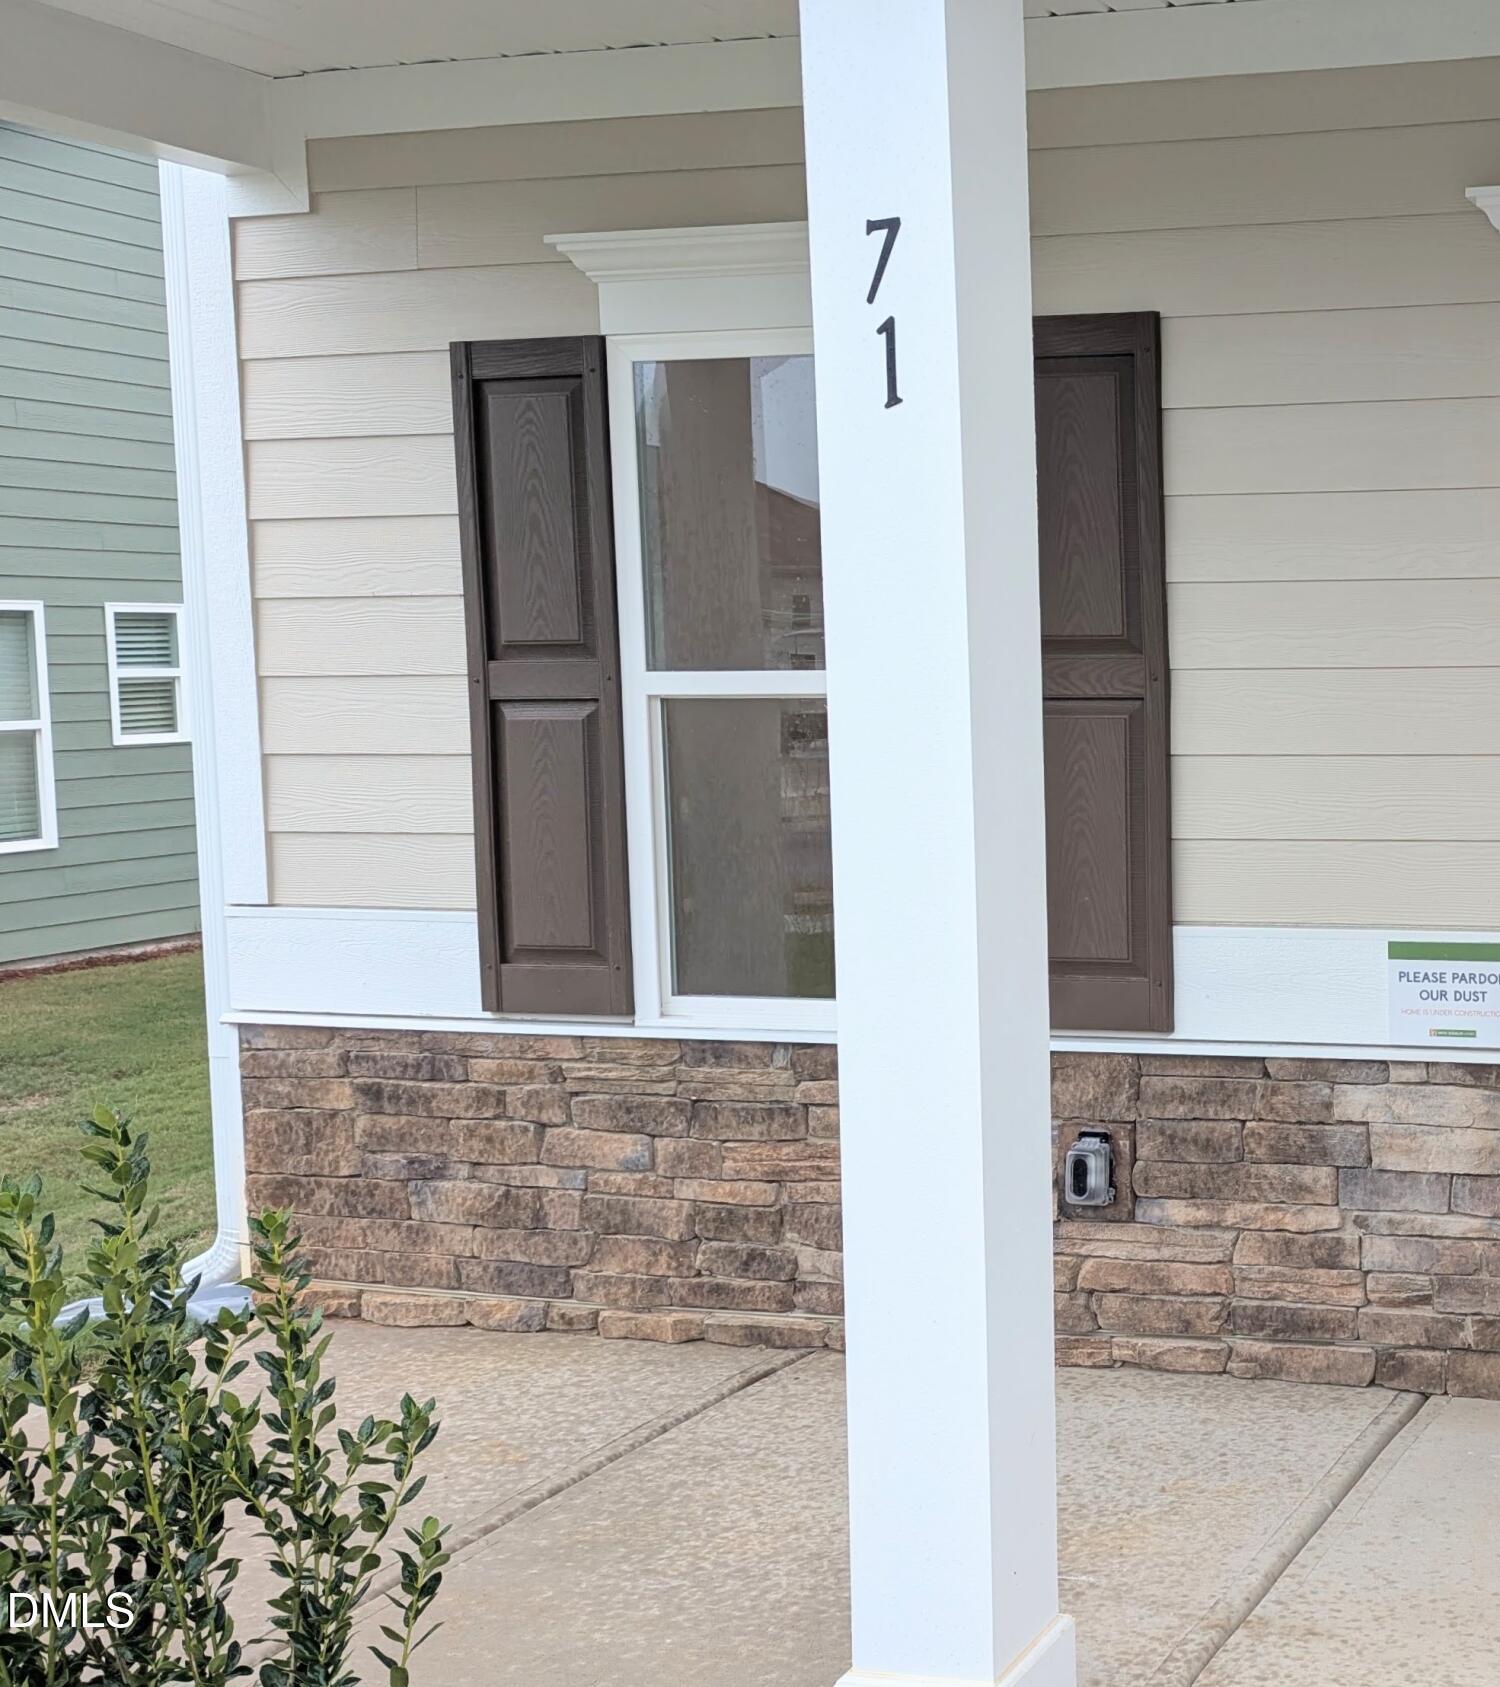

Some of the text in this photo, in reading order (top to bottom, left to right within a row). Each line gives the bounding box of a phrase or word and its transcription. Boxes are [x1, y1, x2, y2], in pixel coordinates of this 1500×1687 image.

[1398, 971, 1447, 984] PLEASE
[1419, 989, 1488, 1002] OUR DUST
